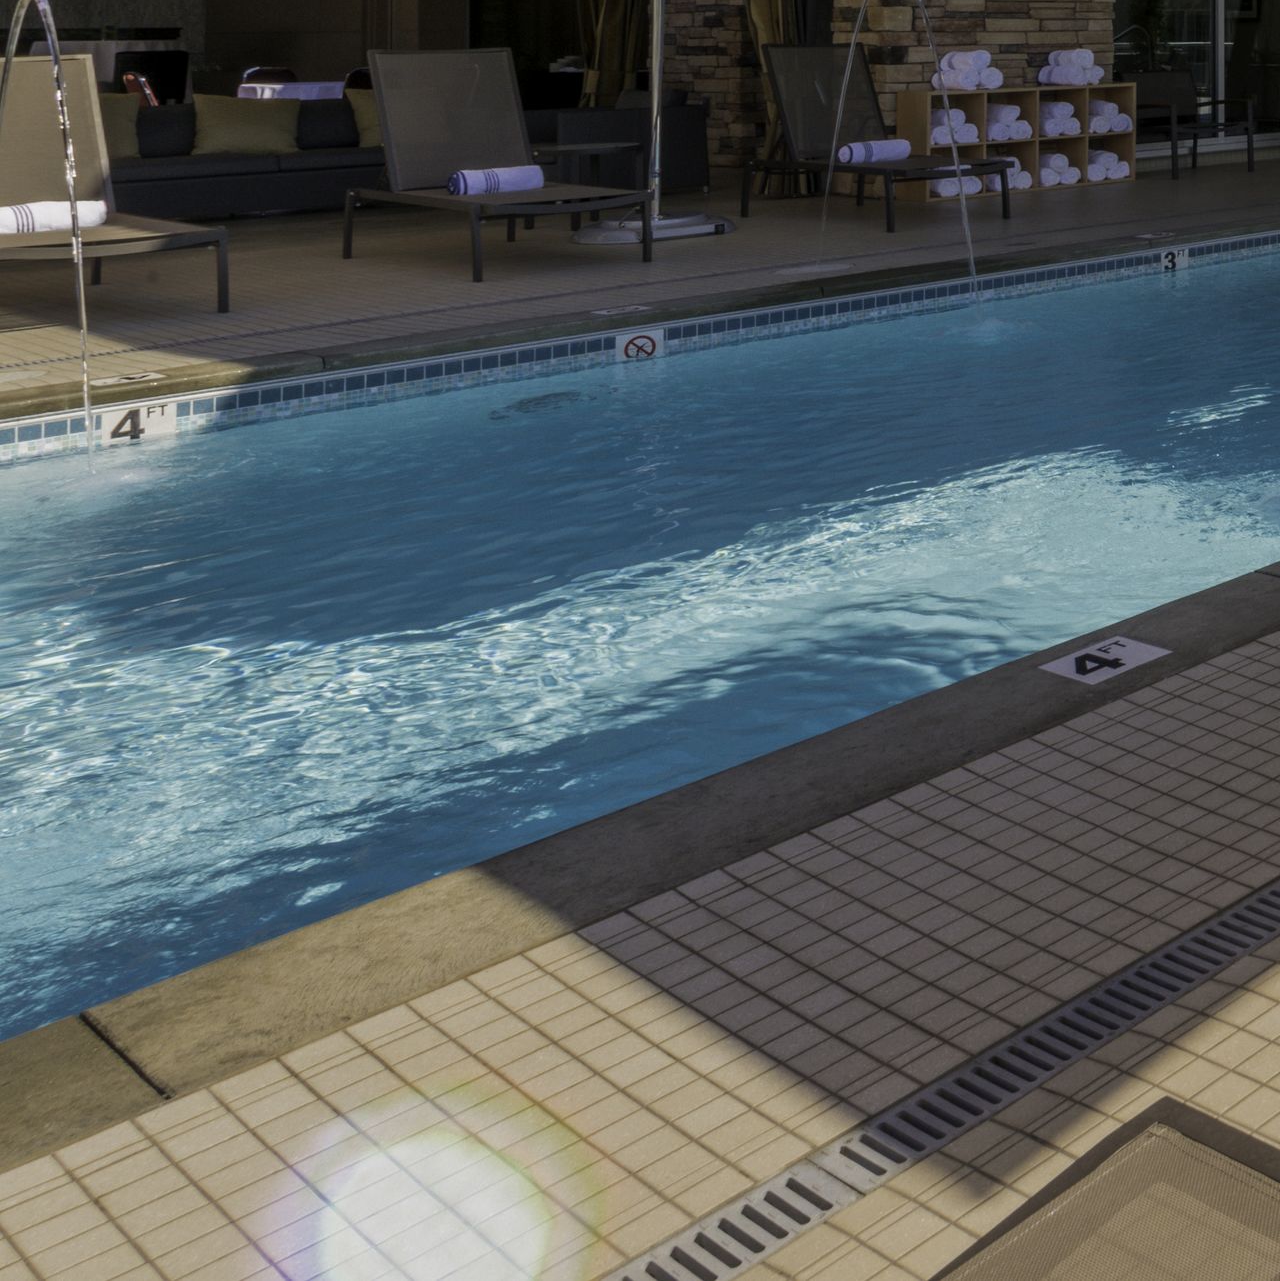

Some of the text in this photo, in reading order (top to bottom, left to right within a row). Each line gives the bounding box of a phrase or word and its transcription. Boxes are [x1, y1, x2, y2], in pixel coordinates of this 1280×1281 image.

[1164, 248, 1185, 271] 3 FT
[110, 404, 168, 440] 4 FT
[1074, 639, 1127, 677] 4 FT
